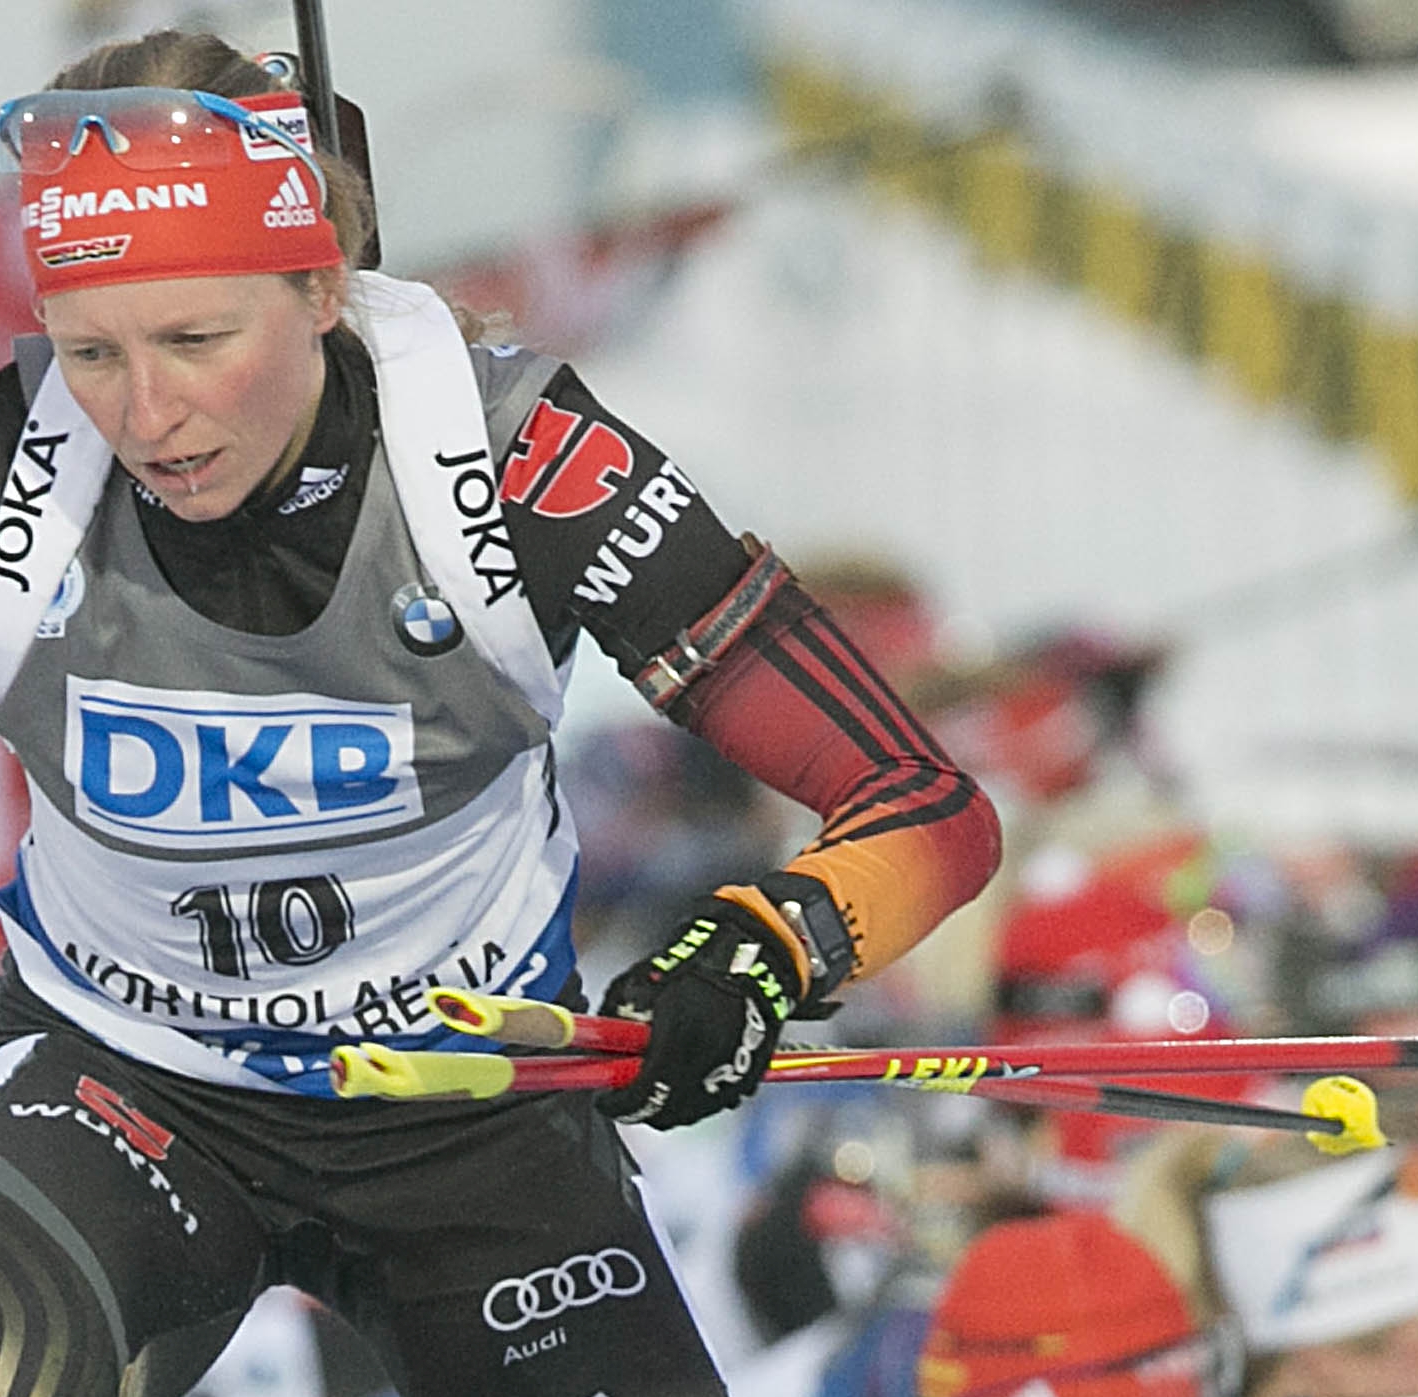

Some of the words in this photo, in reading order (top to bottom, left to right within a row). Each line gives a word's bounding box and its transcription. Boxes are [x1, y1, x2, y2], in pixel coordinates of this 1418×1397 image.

[434, 449, 525, 606] JOKA
[574, 458, 698, 606] WÜRT
[79, 708, 397, 823] DKB
[171, 873, 356, 980] 10
[652, 918, 718, 972] LEKI
[882, 1057, 988, 1080] LEKI
[503, 1327, 567, 1366] Audi
